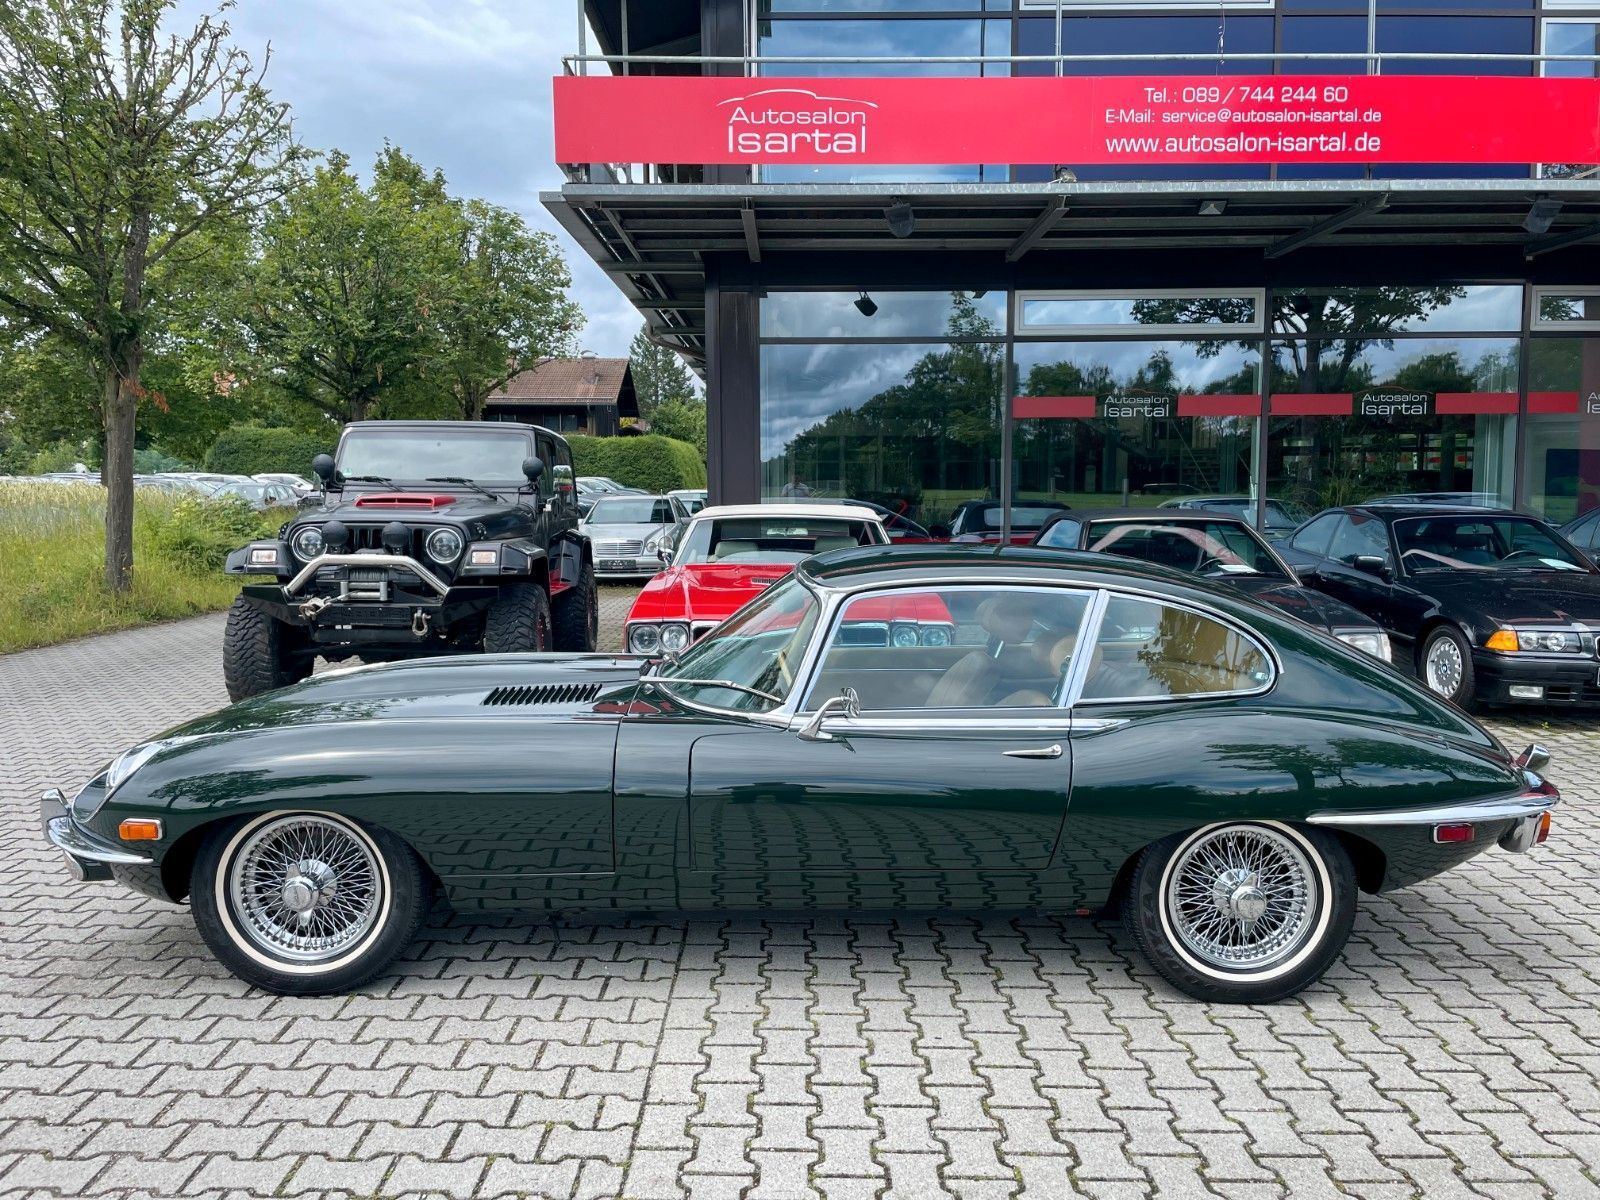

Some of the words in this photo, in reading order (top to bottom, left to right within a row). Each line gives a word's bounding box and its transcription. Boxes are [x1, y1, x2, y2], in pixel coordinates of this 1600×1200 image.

[1144, 87, 1177, 103] Tel.:
[1182, 87, 1220, 103] 089
[1239, 87, 1275, 102] 744
[1281, 87, 1317, 103] 244
[1323, 87, 1348, 103] 60
[728, 106, 866, 125] Autosalon
[1105, 109, 1155, 124] E-Mail:
[1162, 108, 1382, 123] service@autosalon-isartal.de
[728, 125, 866, 154] Isartal
[1105, 131, 1381, 153] www.autosalon-isartal.de
[1104, 395, 1169, 404] Autosalon
[1362, 393, 1427, 401] Autosalon
[1588, 391, 1600, 400] A
[1103, 403, 1169, 417] Isartal
[1361, 401, 1427, 415] Isartal
